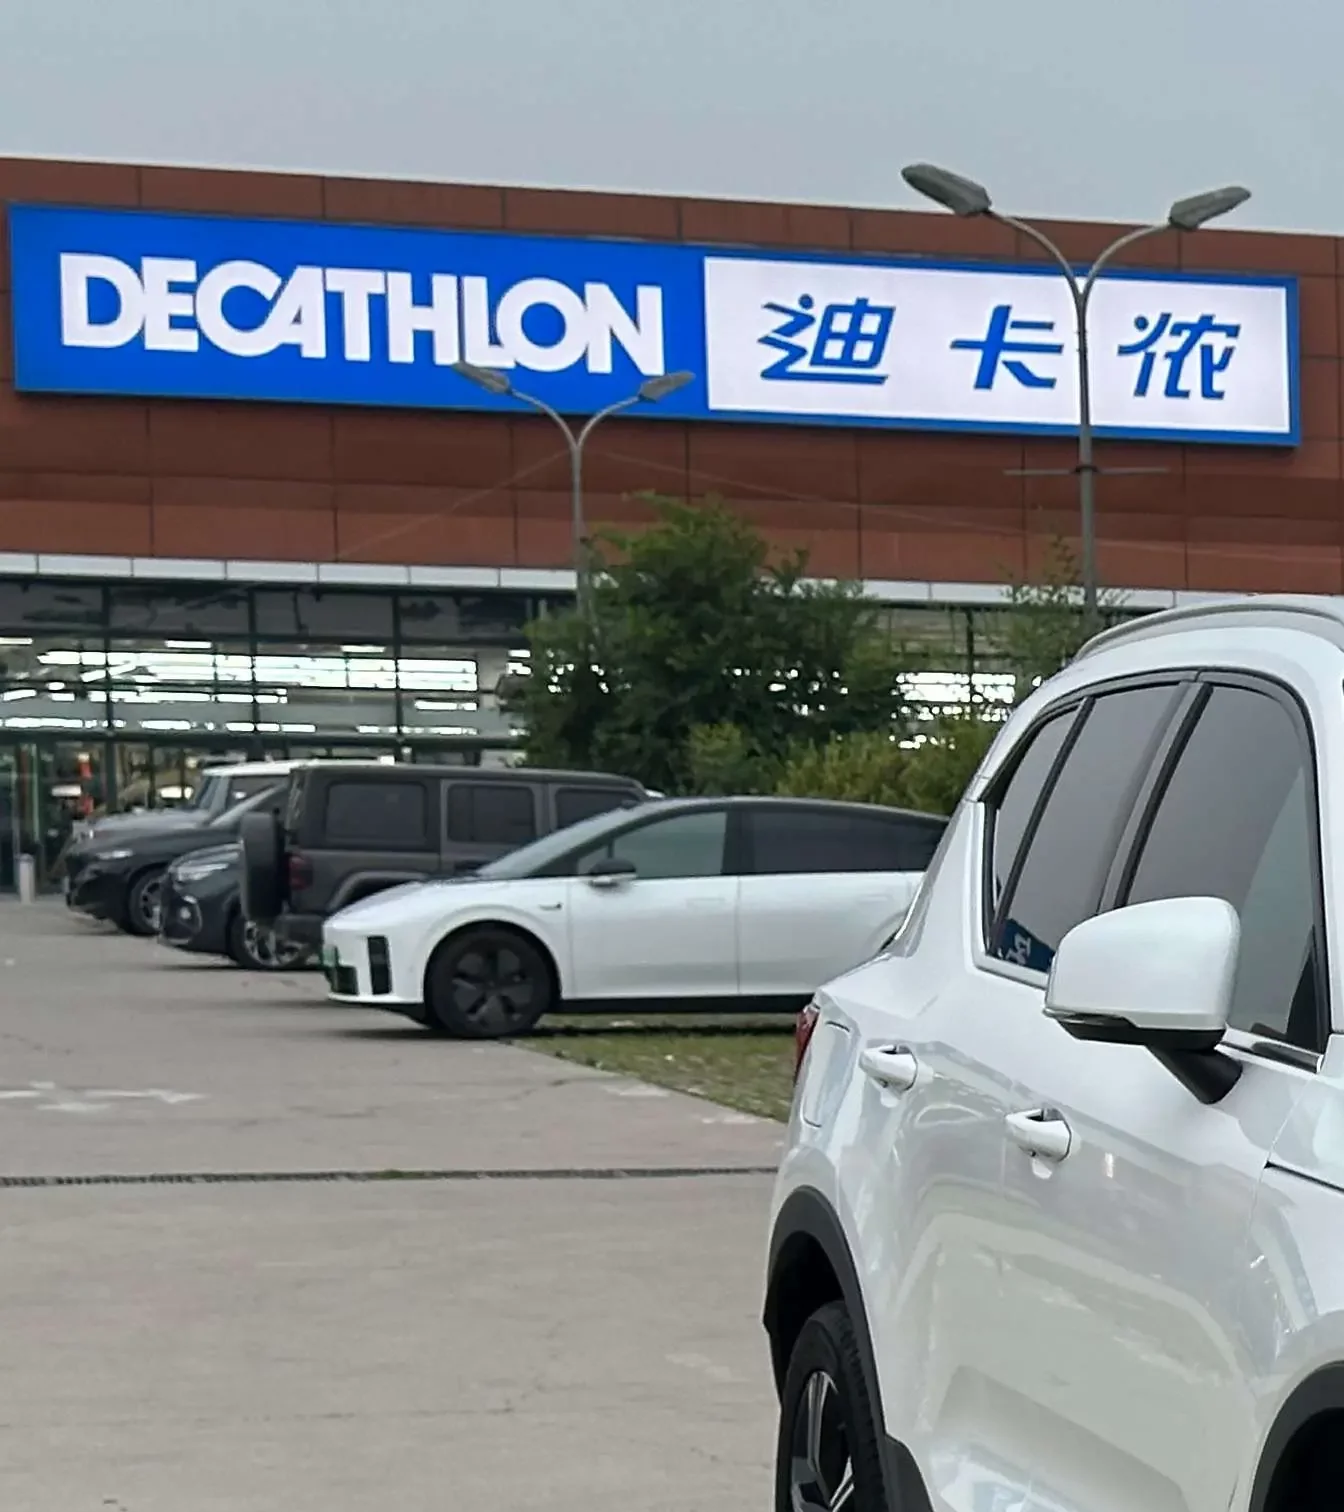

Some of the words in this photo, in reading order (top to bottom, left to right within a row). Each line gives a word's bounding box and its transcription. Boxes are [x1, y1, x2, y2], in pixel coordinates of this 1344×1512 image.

[59, 252, 665, 376] DECATHLON
[758, 293, 1241, 400] 迪卡侬
